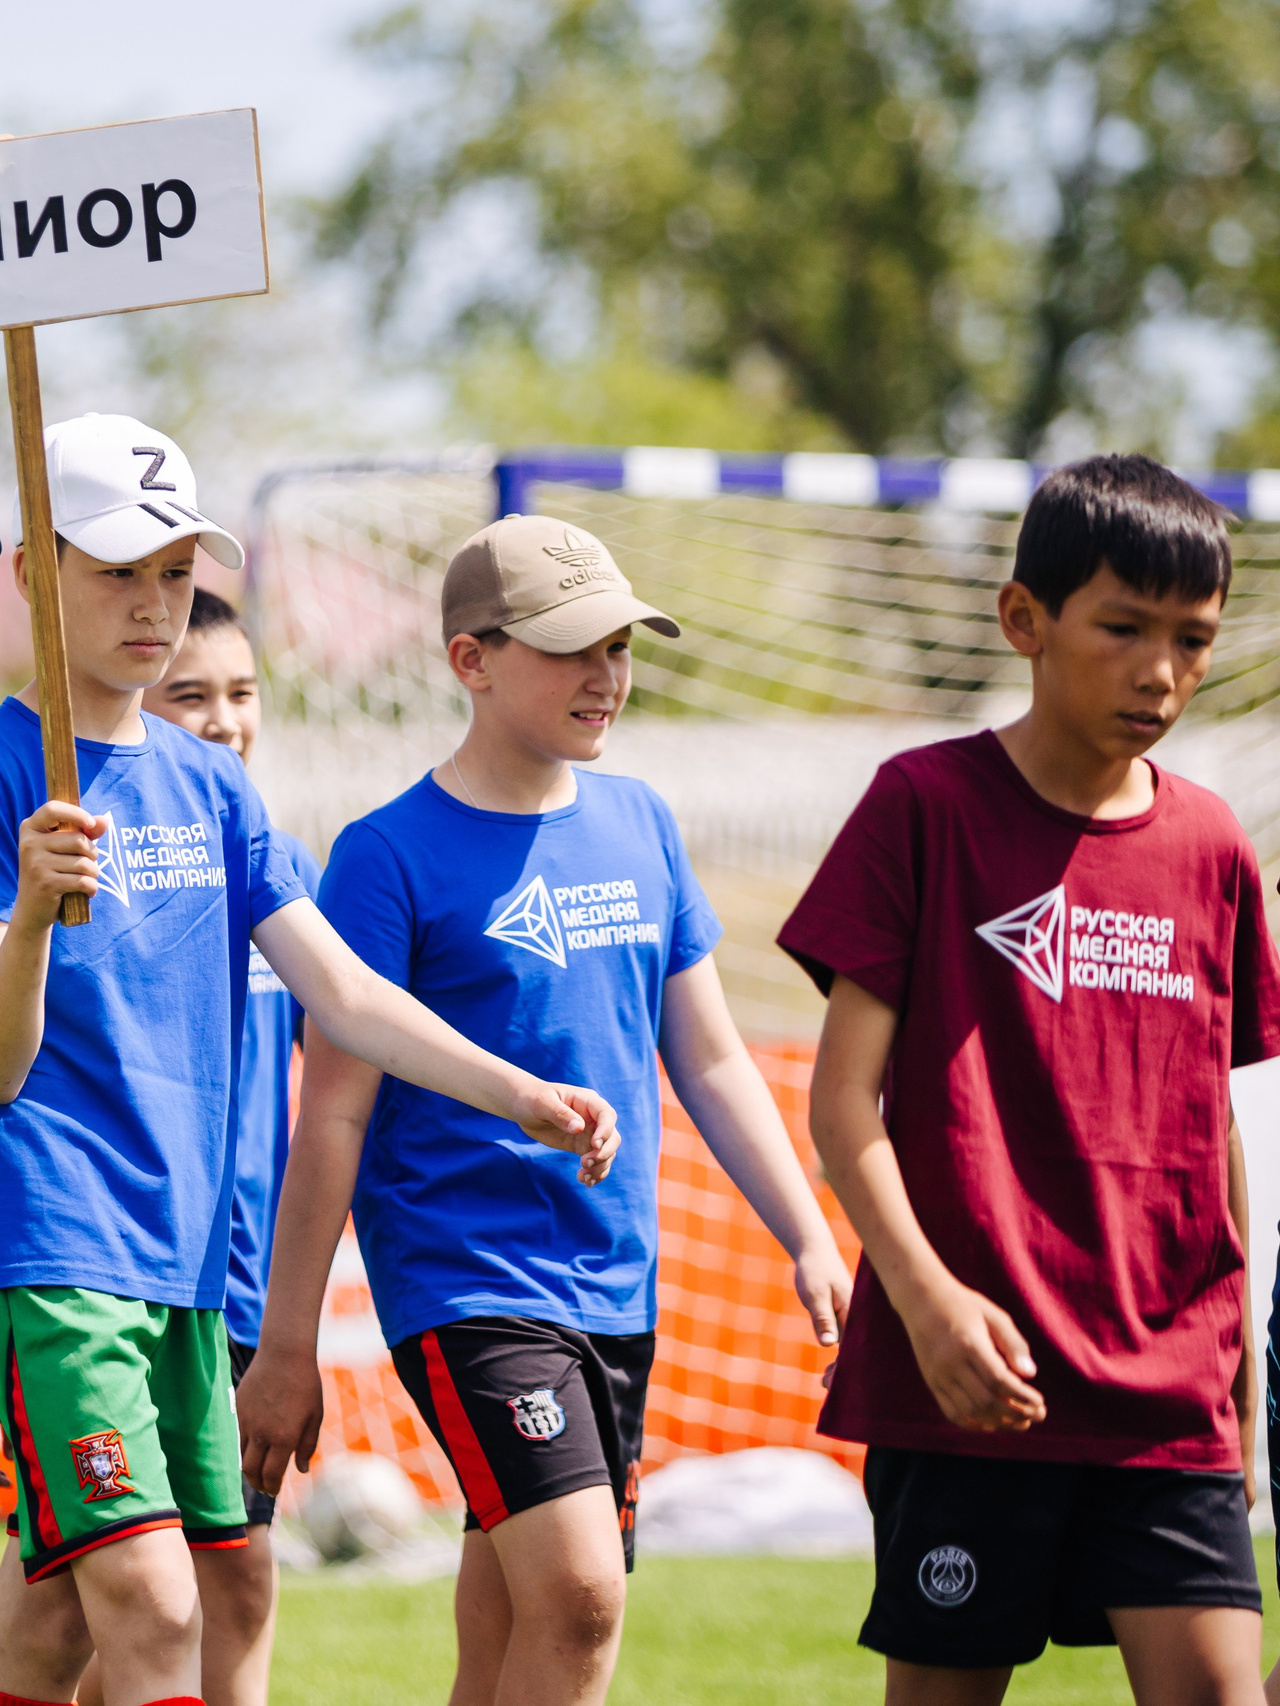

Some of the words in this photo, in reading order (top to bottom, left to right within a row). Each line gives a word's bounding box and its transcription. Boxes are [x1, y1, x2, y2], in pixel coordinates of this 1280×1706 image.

[559, 568, 618, 591] adida
[120, 822, 207, 846] РУССКАЯ
[126, 846, 209, 869] МЕДНАЯ
[553, 879, 639, 907] РУССКАЯ
[559, 901, 641, 928] МЕДНАЯ
[1070, 906, 1174, 944] РУССКАЯ
[566, 923, 660, 950] КОМПАНИЯ
[1070, 934, 1169, 970] МЕДНАЯ
[1070, 961, 1194, 1001] КОМПАНИЯ
[931, 1548, 968, 1566] PARIS
